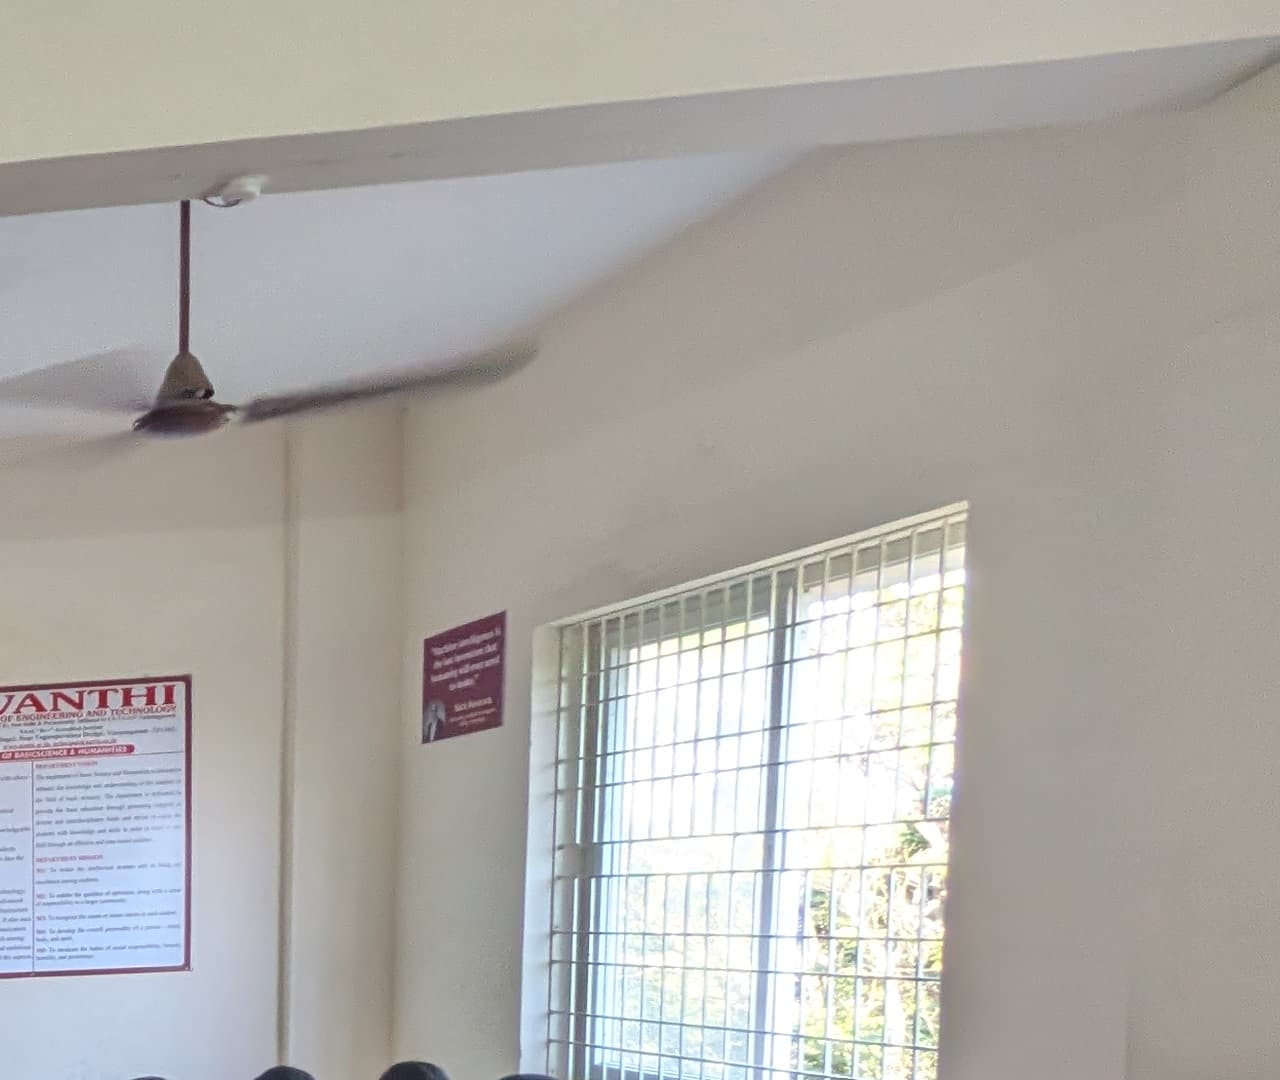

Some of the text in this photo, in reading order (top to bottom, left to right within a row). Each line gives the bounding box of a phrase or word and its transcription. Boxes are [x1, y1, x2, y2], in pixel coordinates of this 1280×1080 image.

[16, 711, 83, 722] ENGINEERING
[87, 709, 107, 717] AND
[111, 705, 176, 716] TECHNOLOGY
[1, 751, 12, 759] OF
[78, 746, 127, 755] HUMANITIES
